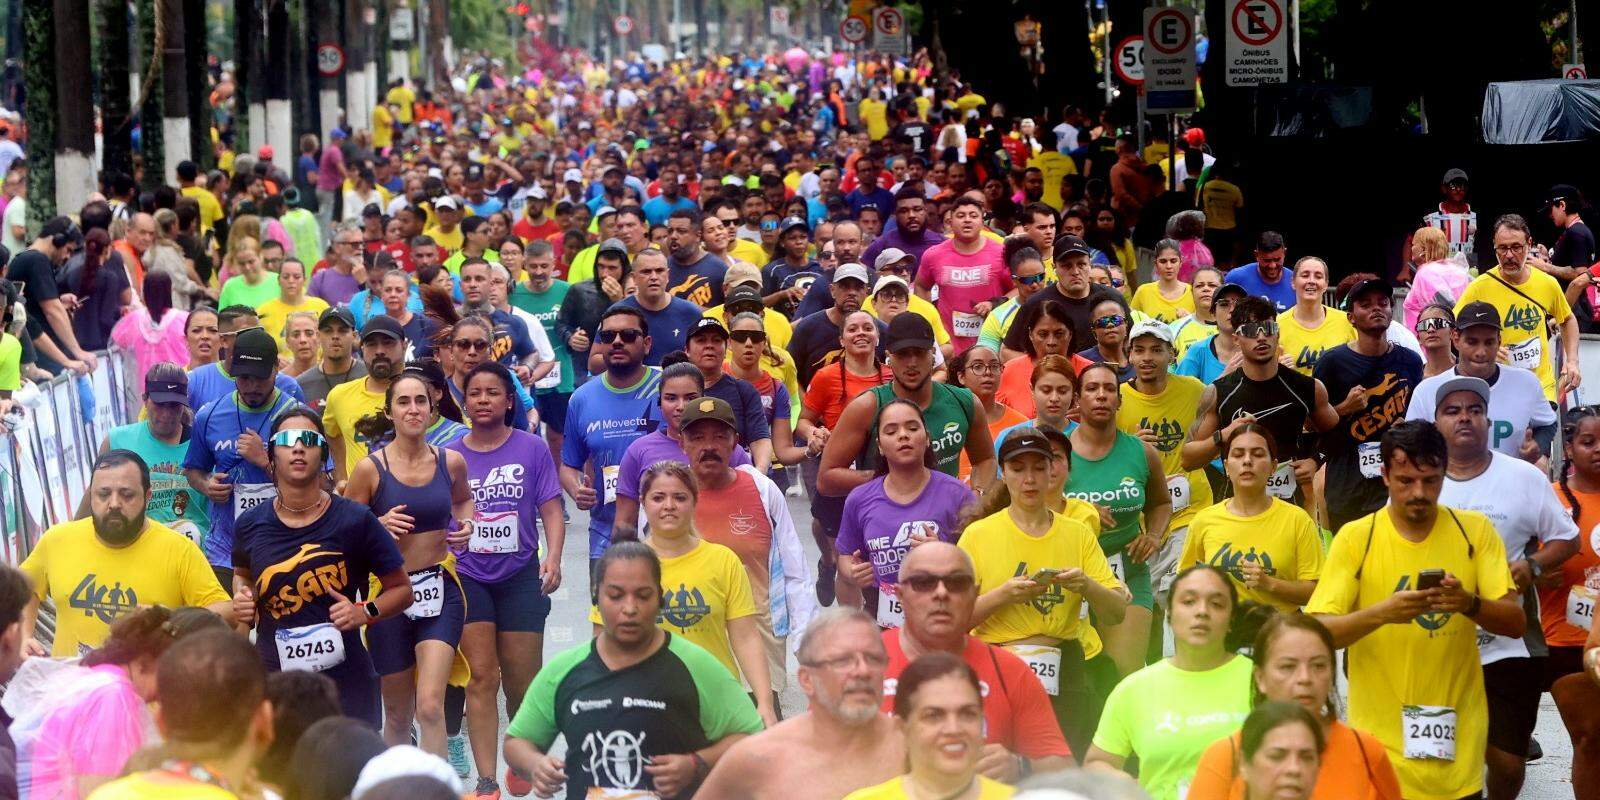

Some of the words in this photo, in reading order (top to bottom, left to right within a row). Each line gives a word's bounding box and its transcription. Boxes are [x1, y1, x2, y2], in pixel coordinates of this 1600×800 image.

[1248, 5, 1266, 35] E
[1161, 18, 1178, 45] E
[1242, 49, 1271, 57] ÔNIBUS
[1234, 57, 1279, 66] CAMINHÕES
[1229, 67, 1284, 75] MICRO-ÔNIBUS
[1232, 76, 1281, 84] CAMIONETAS
[951, 268, 981, 281] ONE
[955, 320, 981, 330] 20749
[1513, 347, 1540, 361] 13536
[602, 416, 648, 430] Movecta
[1266, 474, 1290, 487] 564
[1062, 485, 1140, 503] coporto
[477, 525, 511, 539] 15160
[867, 536, 890, 551] TIME
[414, 586, 440, 603] 082
[889, 600, 902, 613] 15
[285, 639, 335, 659] 26743
[1029, 662, 1056, 678] 525
[1410, 723, 1456, 741] 24023
